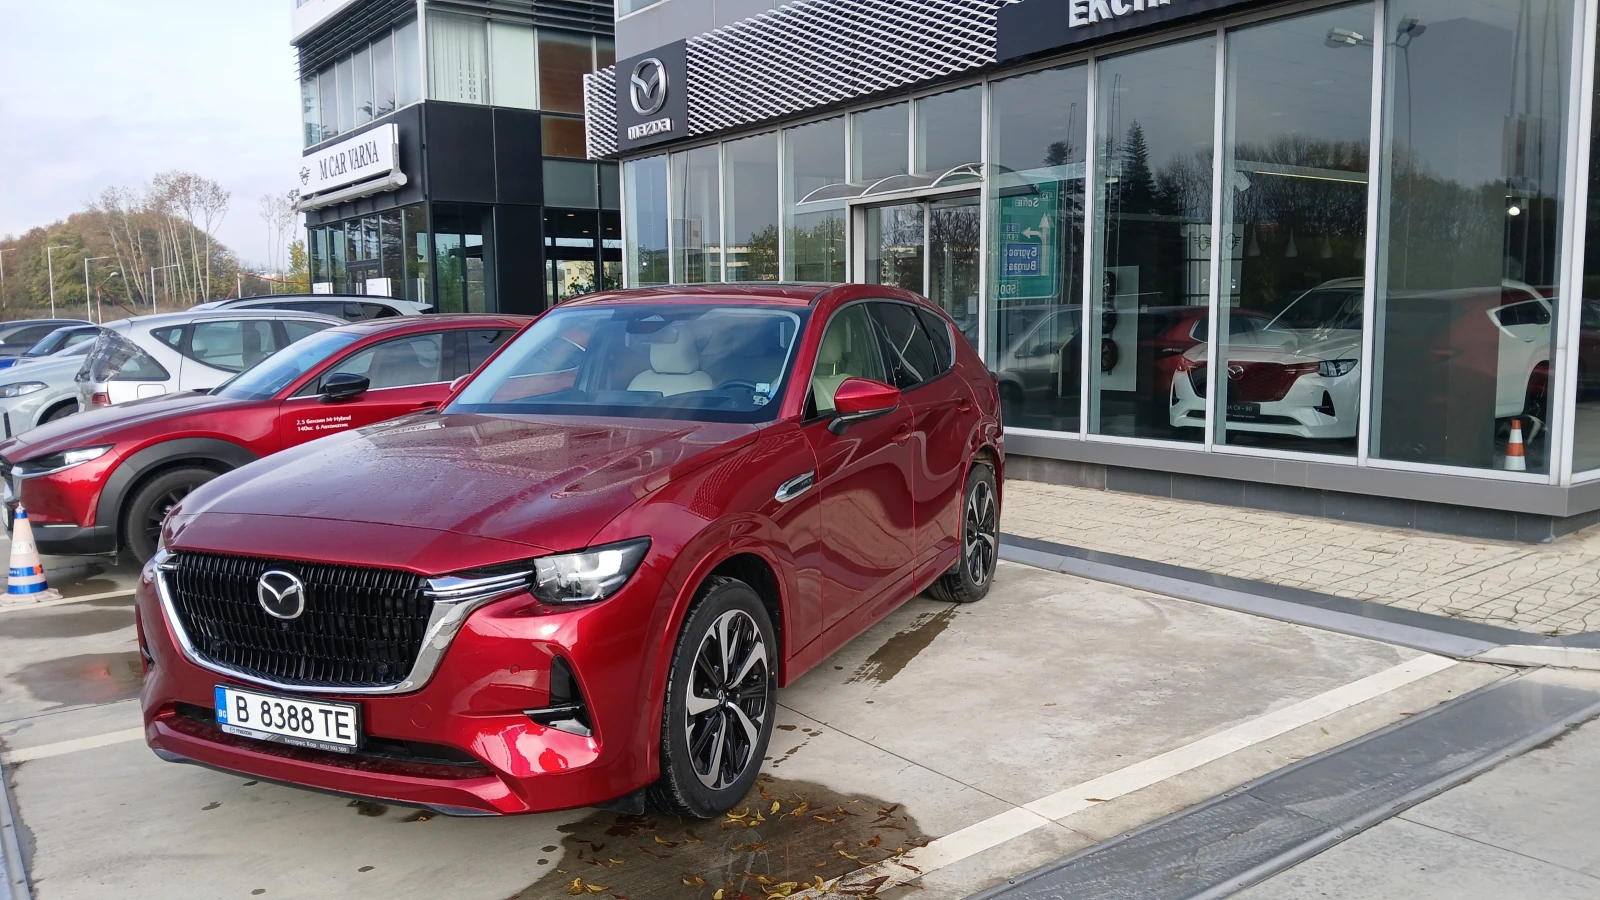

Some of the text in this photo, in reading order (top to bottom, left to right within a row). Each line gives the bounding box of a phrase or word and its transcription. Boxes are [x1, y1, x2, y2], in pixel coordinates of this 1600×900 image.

[628, 117, 672, 140] mazda
[319, 140, 379, 181] M CAR VARNA
[218, 695, 351, 740] BG B 8388 TE
